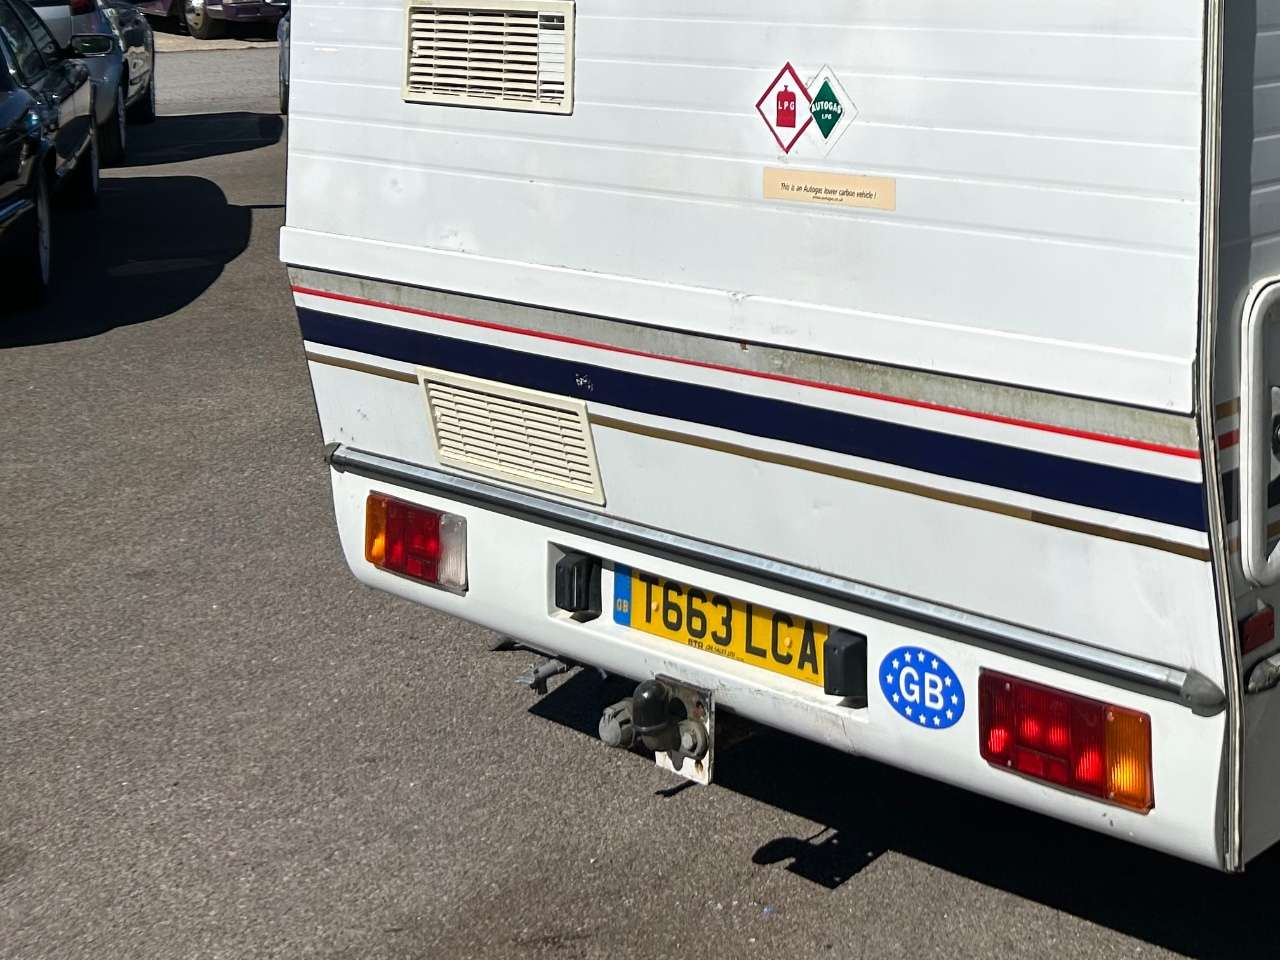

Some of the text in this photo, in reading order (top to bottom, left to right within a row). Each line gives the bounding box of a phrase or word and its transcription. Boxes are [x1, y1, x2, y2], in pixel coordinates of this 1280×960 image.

[778, 100, 795, 110] LPG
[811, 101, 841, 114] AUTOGAS
[639, 574, 819, 675] T663 LCA
[899, 666, 944, 711] GB
